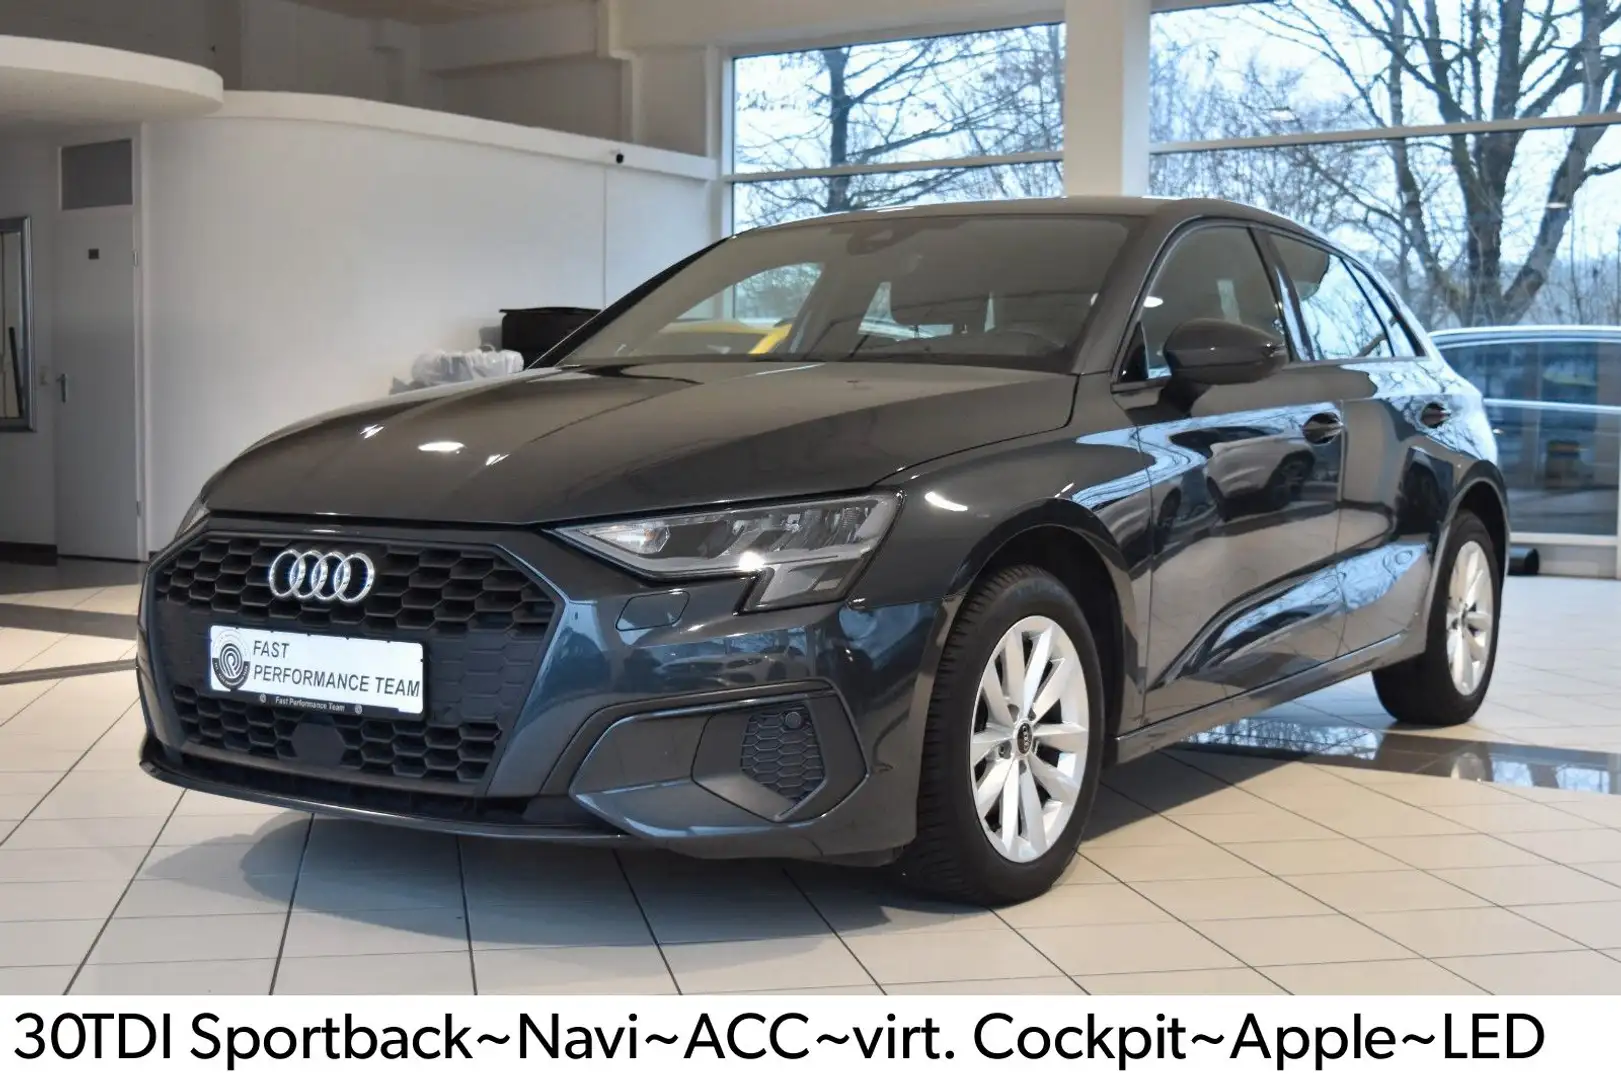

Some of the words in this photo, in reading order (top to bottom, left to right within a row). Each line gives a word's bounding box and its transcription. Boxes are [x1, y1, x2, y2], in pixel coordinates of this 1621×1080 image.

[253, 640, 289, 658] FAST
[253, 664, 370, 692] PERFORMANCE
[375, 677, 420, 697] TEAM
[275, 696, 288, 705] Fast
[289, 698, 327, 710] Performance
[328, 702, 345, 712] Team
